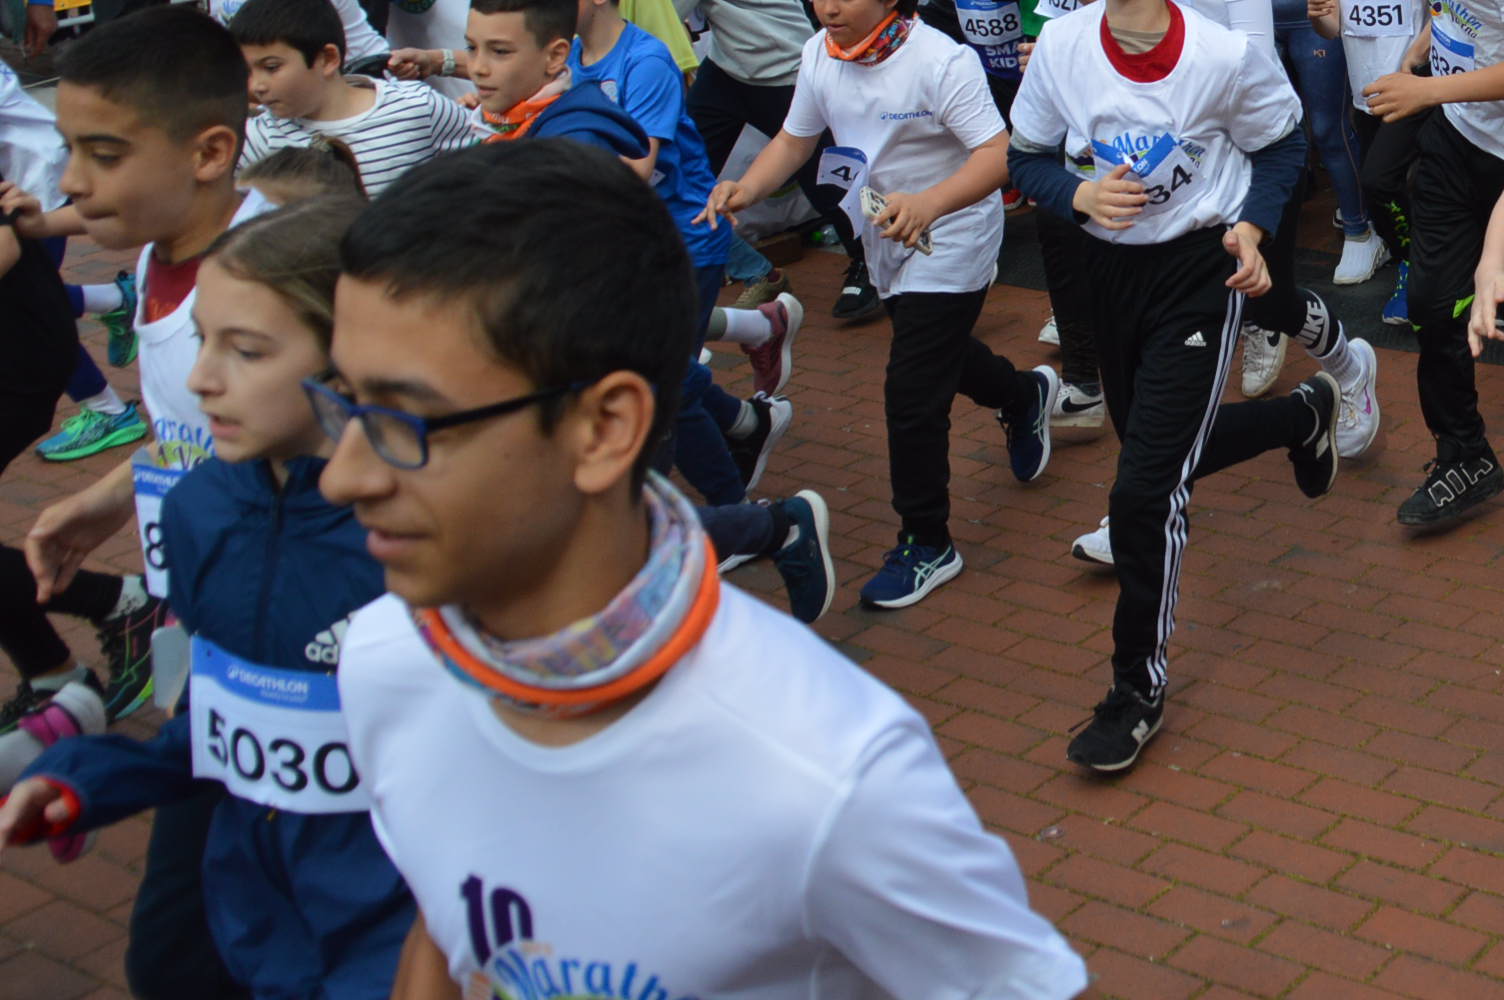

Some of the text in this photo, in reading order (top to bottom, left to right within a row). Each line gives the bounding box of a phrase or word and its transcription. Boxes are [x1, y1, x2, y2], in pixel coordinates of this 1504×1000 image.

[965, 13, 1018, 37] 4588
[1349, 4, 1403, 26] 4351
[889, 110, 933, 120] DECATHLON
[239, 669, 309, 694] DECATHLON
[208, 708, 360, 796] 5030
